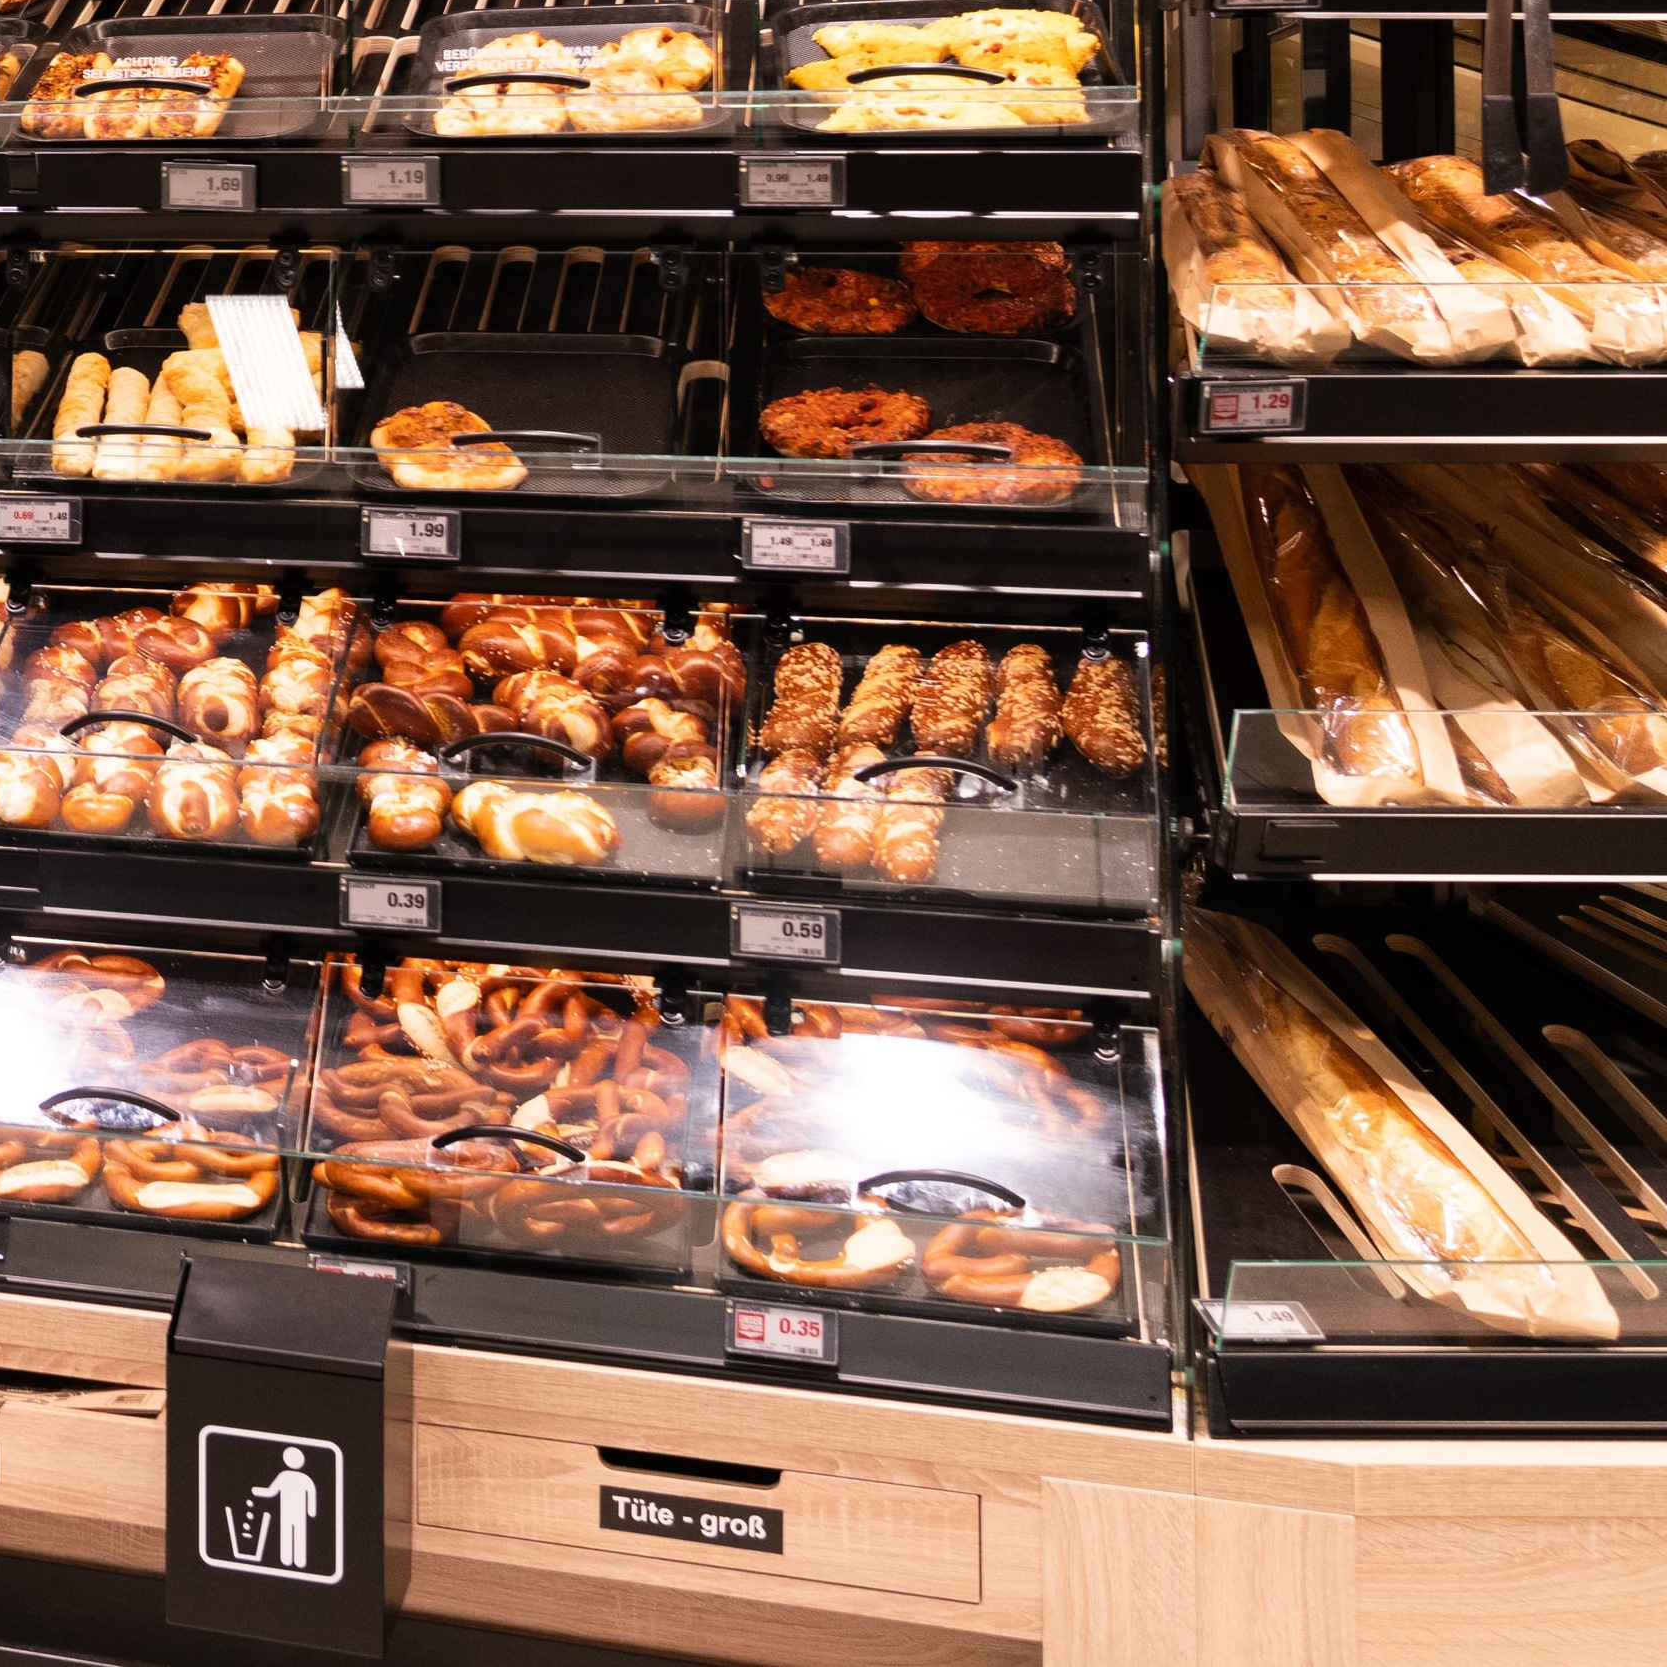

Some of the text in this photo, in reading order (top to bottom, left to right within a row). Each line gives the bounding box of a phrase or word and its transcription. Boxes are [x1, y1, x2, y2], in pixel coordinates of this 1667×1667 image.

[115, 56, 179, 69] ACHTUNG
[387, 169, 425, 185] 1.19
[765, 173, 788, 184] 0.99
[806, 173, 828, 184] 1.49
[205, 177, 241, 192] 1.69
[1252, 393, 1291, 410] 1.29
[13, 510, 34, 521] 0.69
[47, 511, 68, 522] 1.49
[409, 522, 445, 539] 1.99
[769, 536, 792, 547] 1.49
[809, 537, 833, 549] 1.49
[387, 892, 425, 910] 0.39
[781, 920, 824, 940] 0.59
[1252, 1309, 1296, 1323] 1.49
[778, 1316, 821, 1338] 0.35
[611, 1495, 675, 1527] Tüte
[699, 1513, 768, 1539] groß
